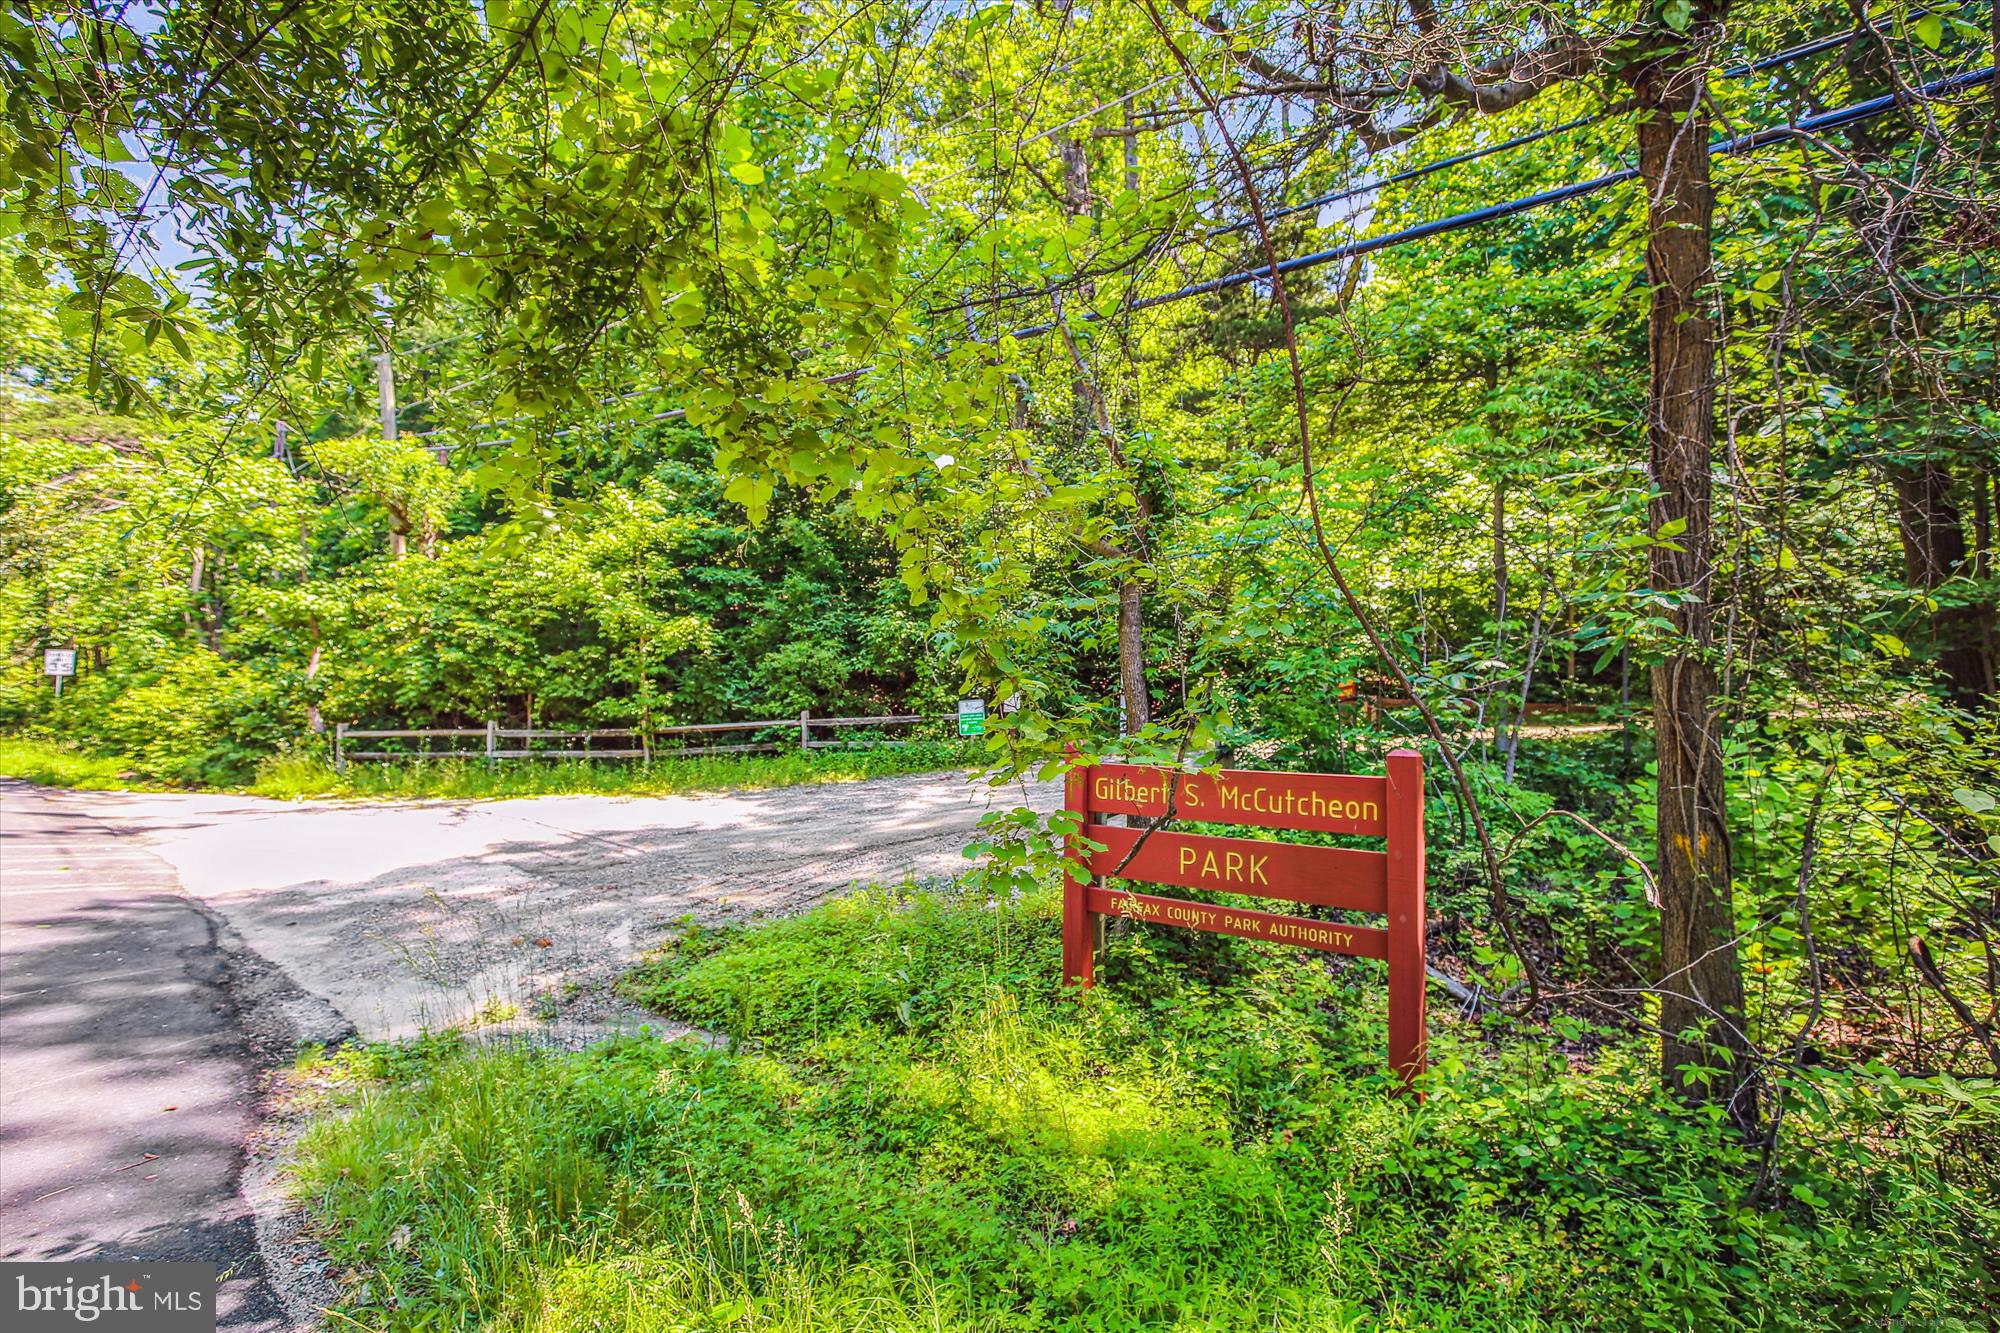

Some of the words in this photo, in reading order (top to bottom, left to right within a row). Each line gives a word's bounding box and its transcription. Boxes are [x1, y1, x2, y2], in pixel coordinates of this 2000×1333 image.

[1095, 777, 1171, 804] Gilbert
[1185, 783, 1204, 808] S.
[1221, 785, 1378, 821] McCutcheon
[1180, 847, 1268, 885] PARK
[1167, 906, 1217, 925] COUNTY
[1225, 915, 1261, 933] PARK
[1269, 923, 1353, 948] AUTHORITY
